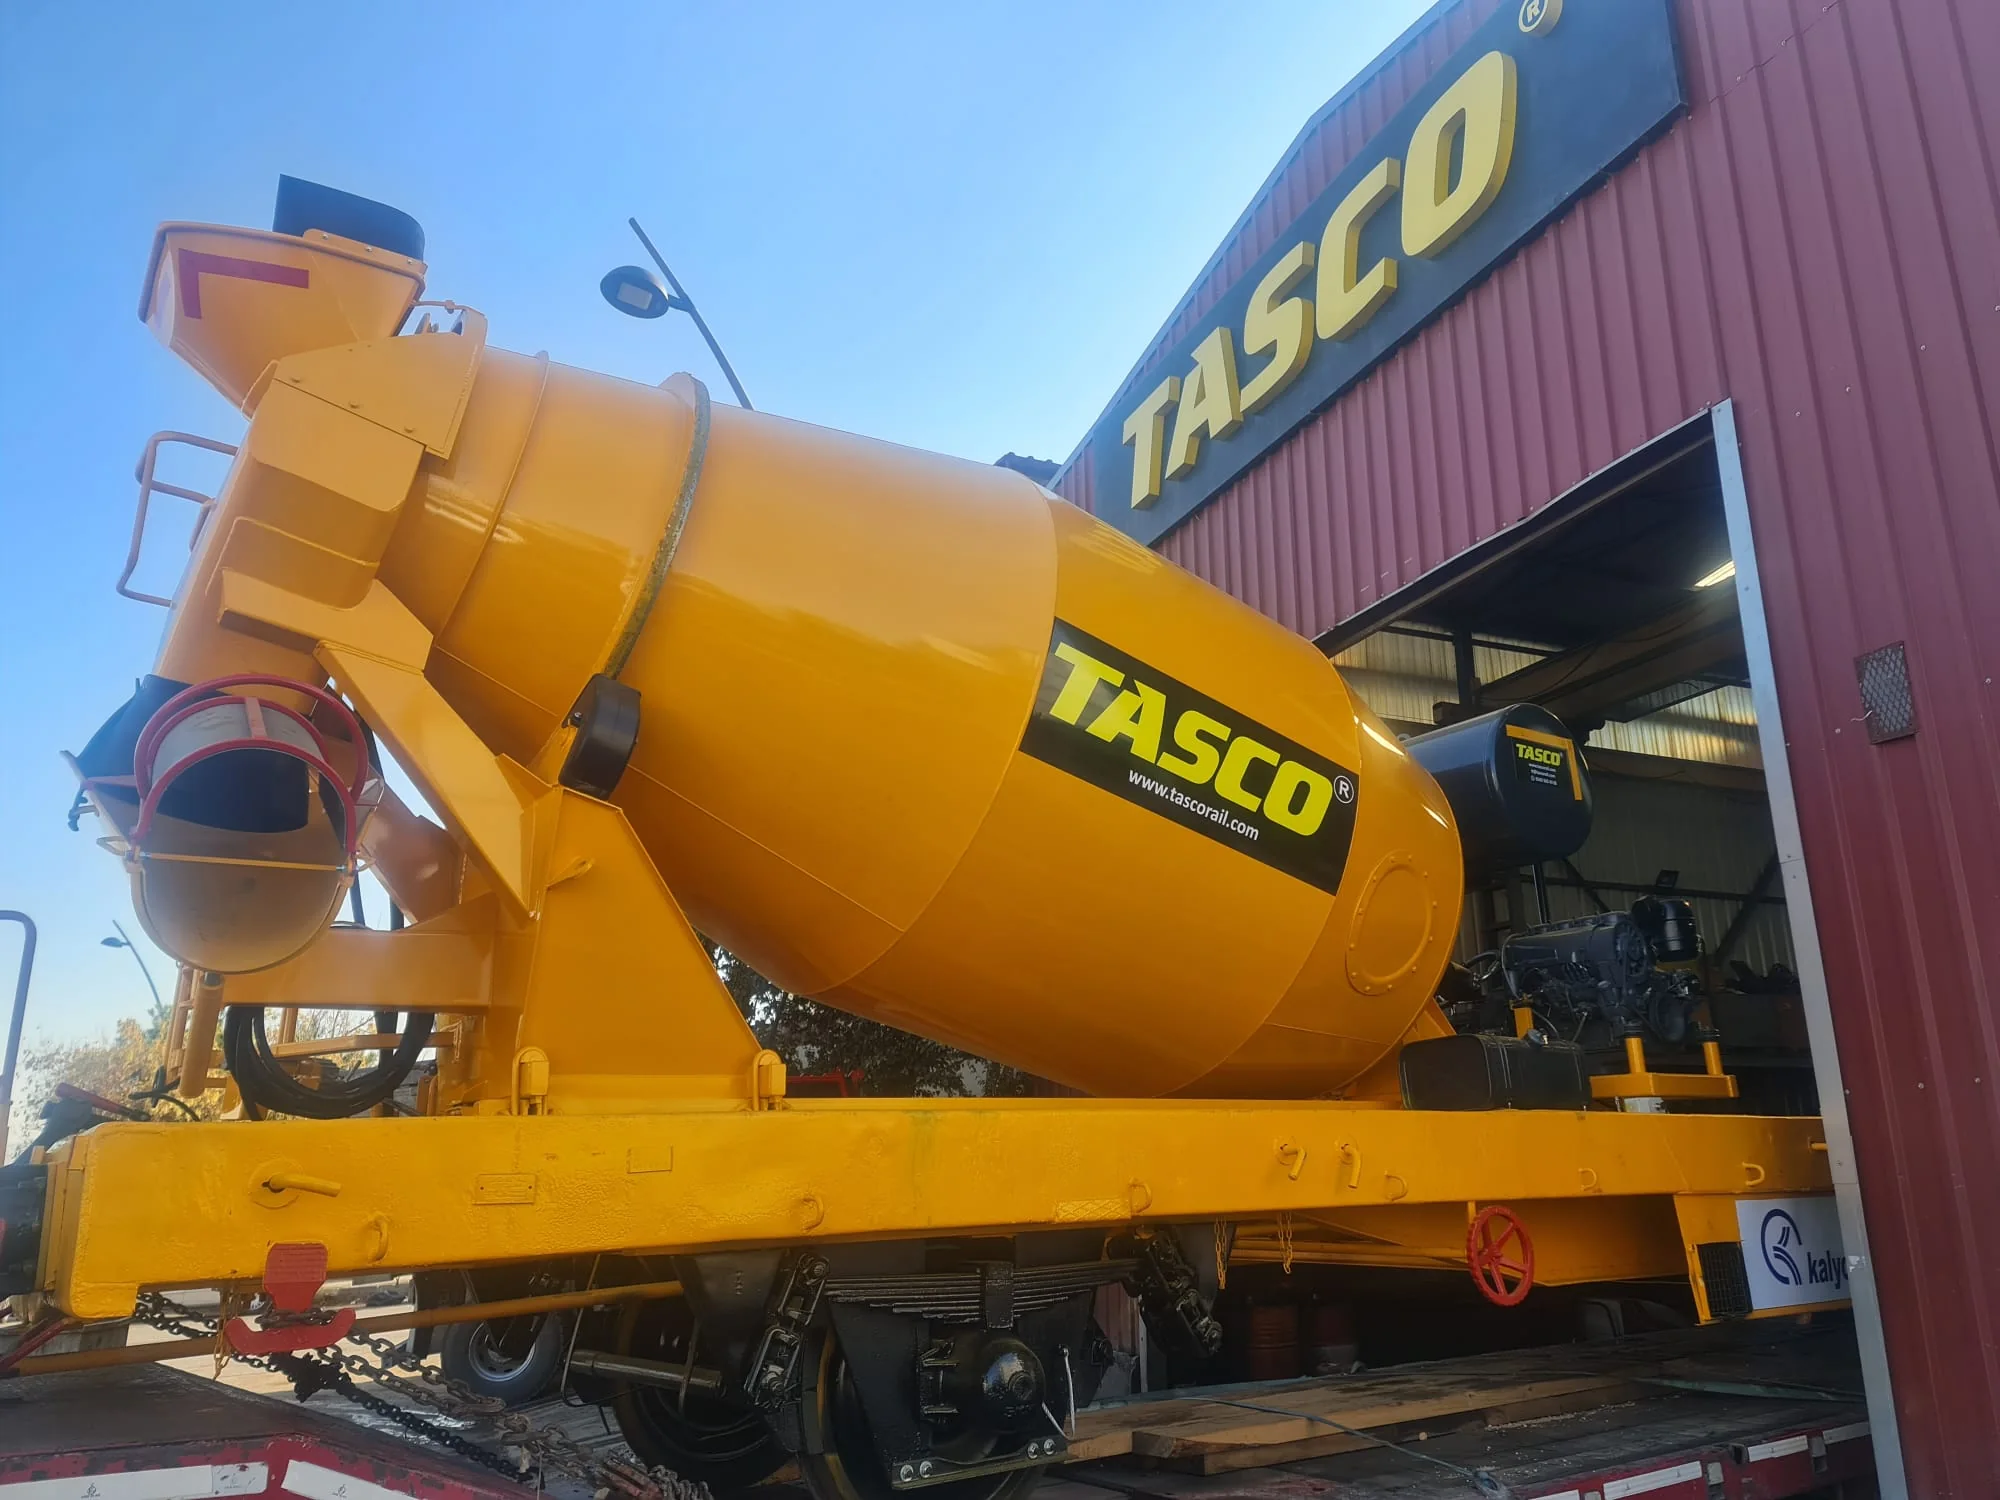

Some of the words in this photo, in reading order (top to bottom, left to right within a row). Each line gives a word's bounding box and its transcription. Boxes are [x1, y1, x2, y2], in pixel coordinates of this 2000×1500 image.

[1122, 50, 1517, 510] TASCO
[1049, 642, 1333, 836] TASCO
[1128, 769, 1260, 841] www.tascorail.com
[1516, 743, 1561, 767] TASCO
